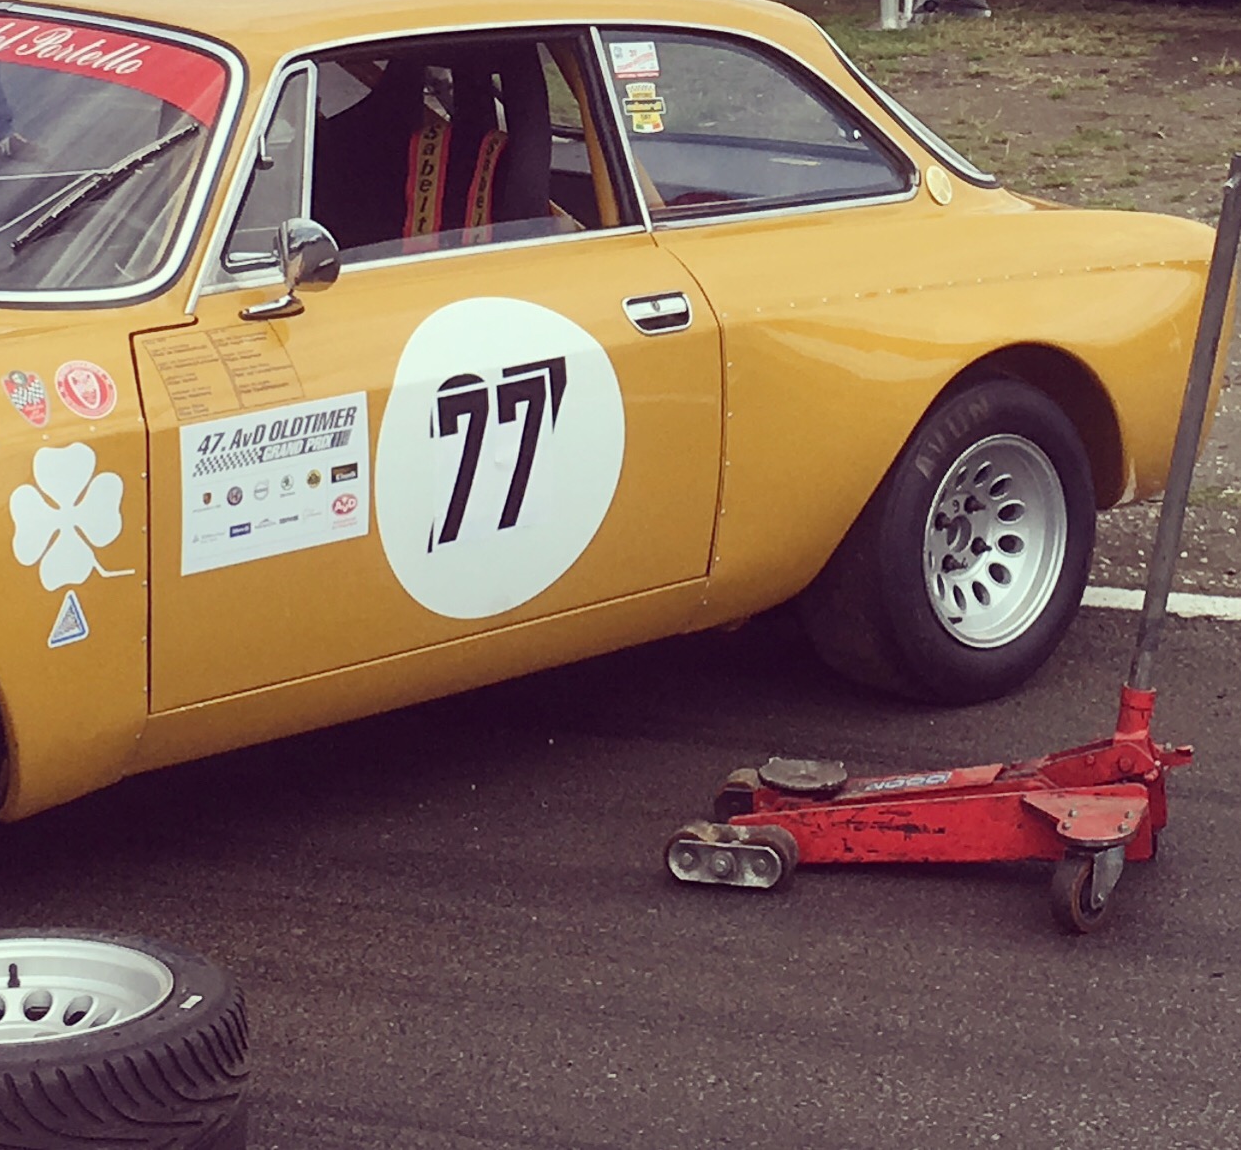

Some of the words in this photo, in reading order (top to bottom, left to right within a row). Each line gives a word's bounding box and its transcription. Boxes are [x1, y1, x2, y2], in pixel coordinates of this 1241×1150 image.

[15, 25, 152, 76] Portello
[196, 431, 227, 456] 47.
[229, 424, 267, 451] AvD
[268, 406, 358, 442] OLDTIMER
[262, 438, 305, 462] GRAND
[305, 433, 334, 454] PRIX
[431, 360, 559, 551] 77
